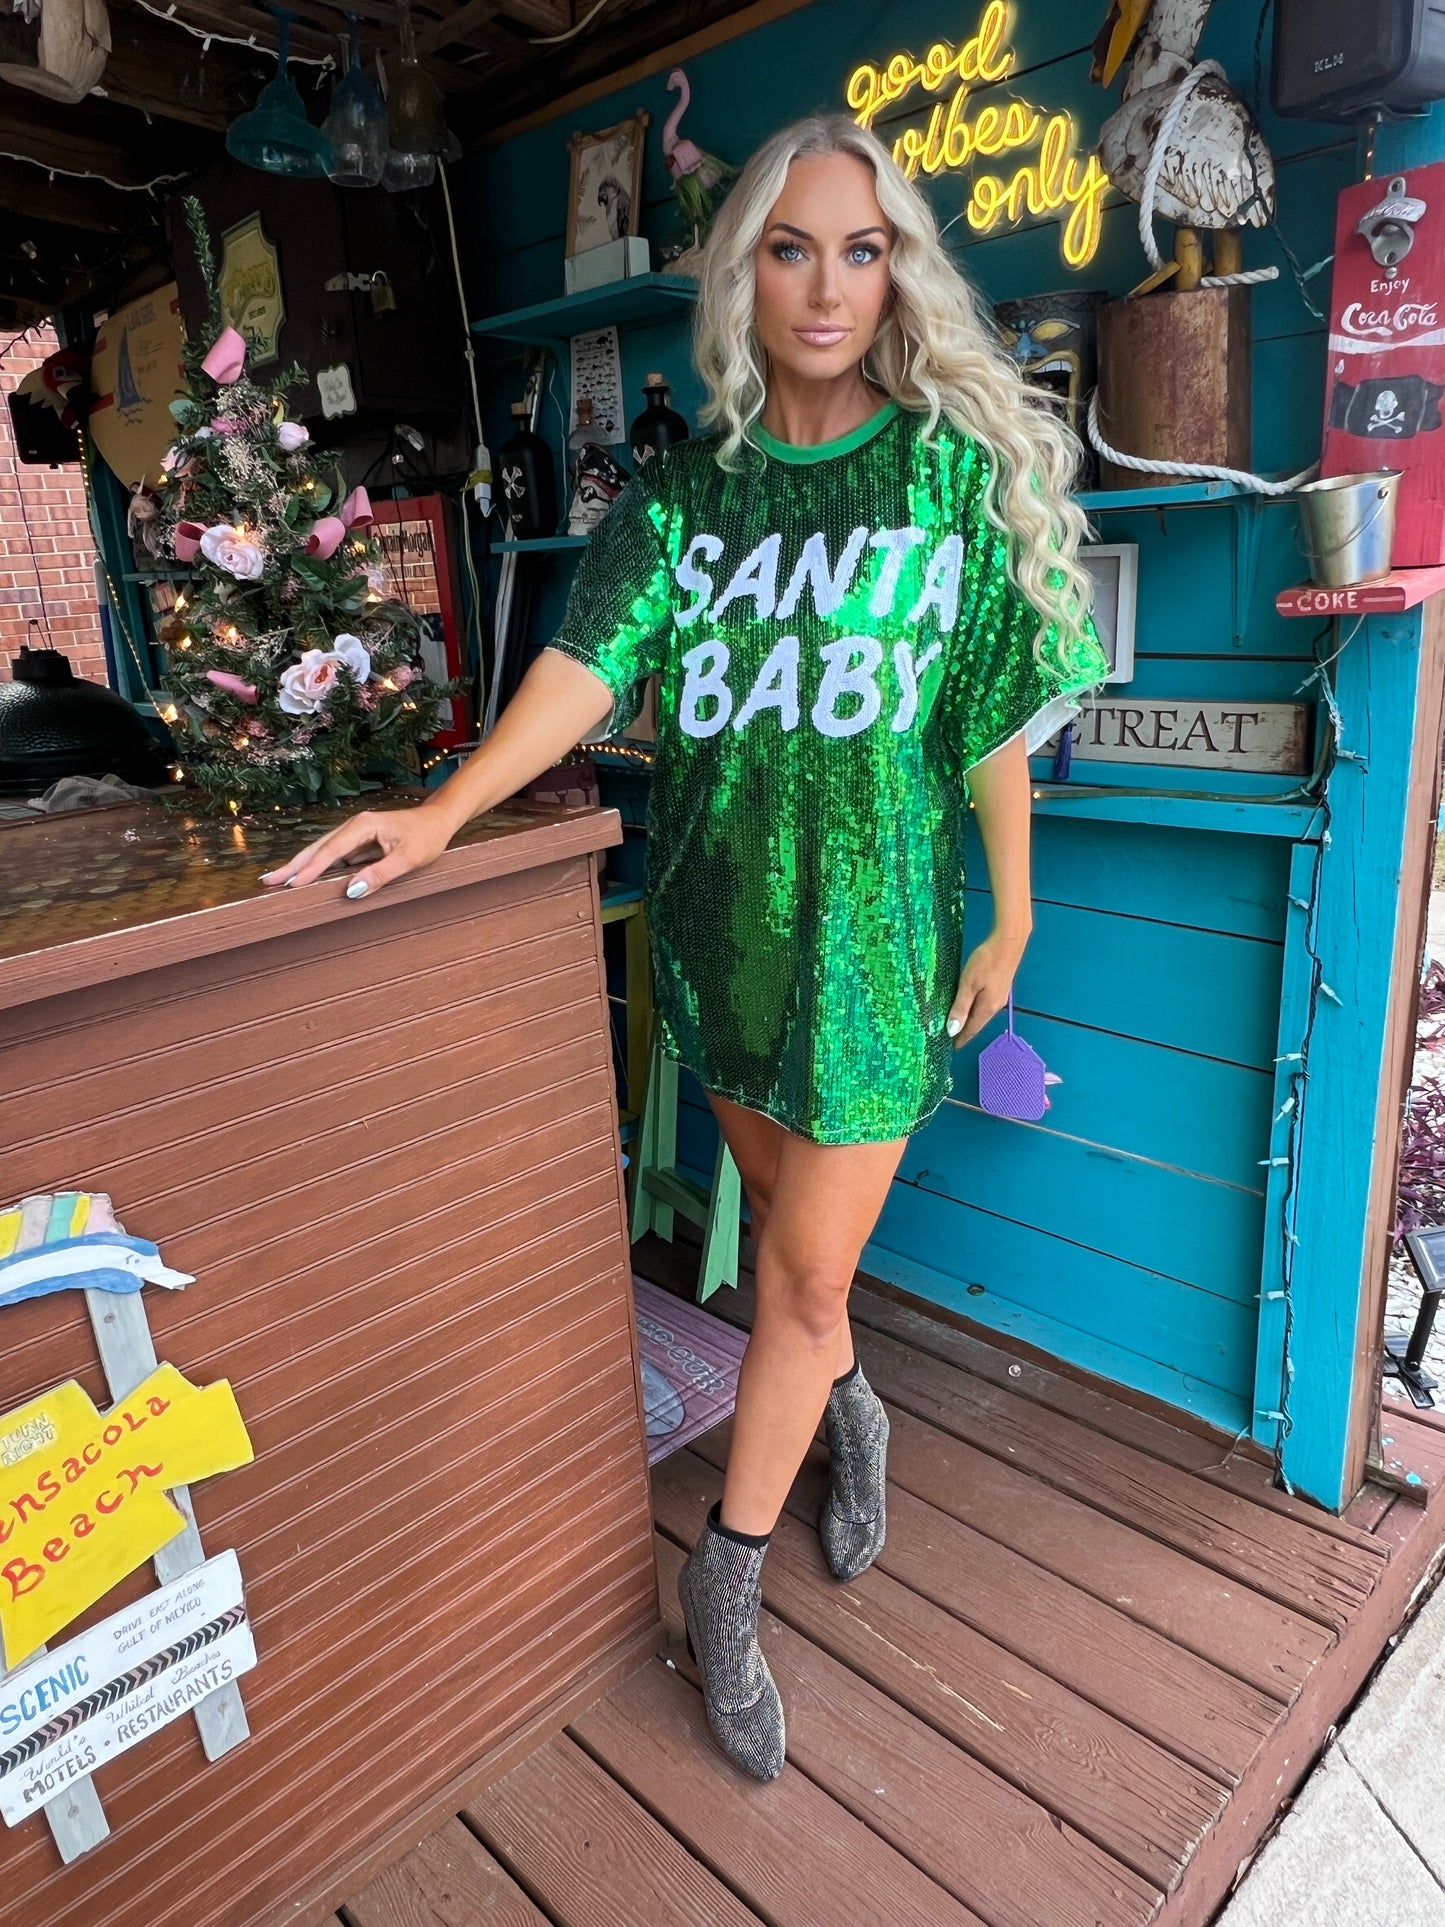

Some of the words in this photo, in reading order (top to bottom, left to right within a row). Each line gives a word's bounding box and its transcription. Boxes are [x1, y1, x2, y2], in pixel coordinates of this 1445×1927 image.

[847, 0, 1012, 129] good
[892, 84, 1041, 182] vibes
[967, 116, 1109, 265] only
[1341, 302, 1393, 337] Coca
[1393, 302, 1438, 331] Cola
[1370, 278, 1410, 296] Enjoy
[673, 526, 964, 633] SANTA
[1297, 591, 1358, 612] COKE
[679, 635, 943, 738] BABY
[1, 1412, 50, 1450] TURN
[1, 1424, 55, 1466] RIGHT
[113, 1616, 143, 1640] DRIVE
[149, 1598, 171, 1618] EAST
[175, 1579, 206, 1603] ALONG
[118, 1629, 146, 1654] GULF
[149, 1618, 162, 1634] OF
[165, 1596, 202, 1625] MEXICO
[0, 1655, 90, 1736] SCENIC
[23, 1745, 97, 1804] MOTELS
[116, 1658, 233, 1743] RESTAURANTS
